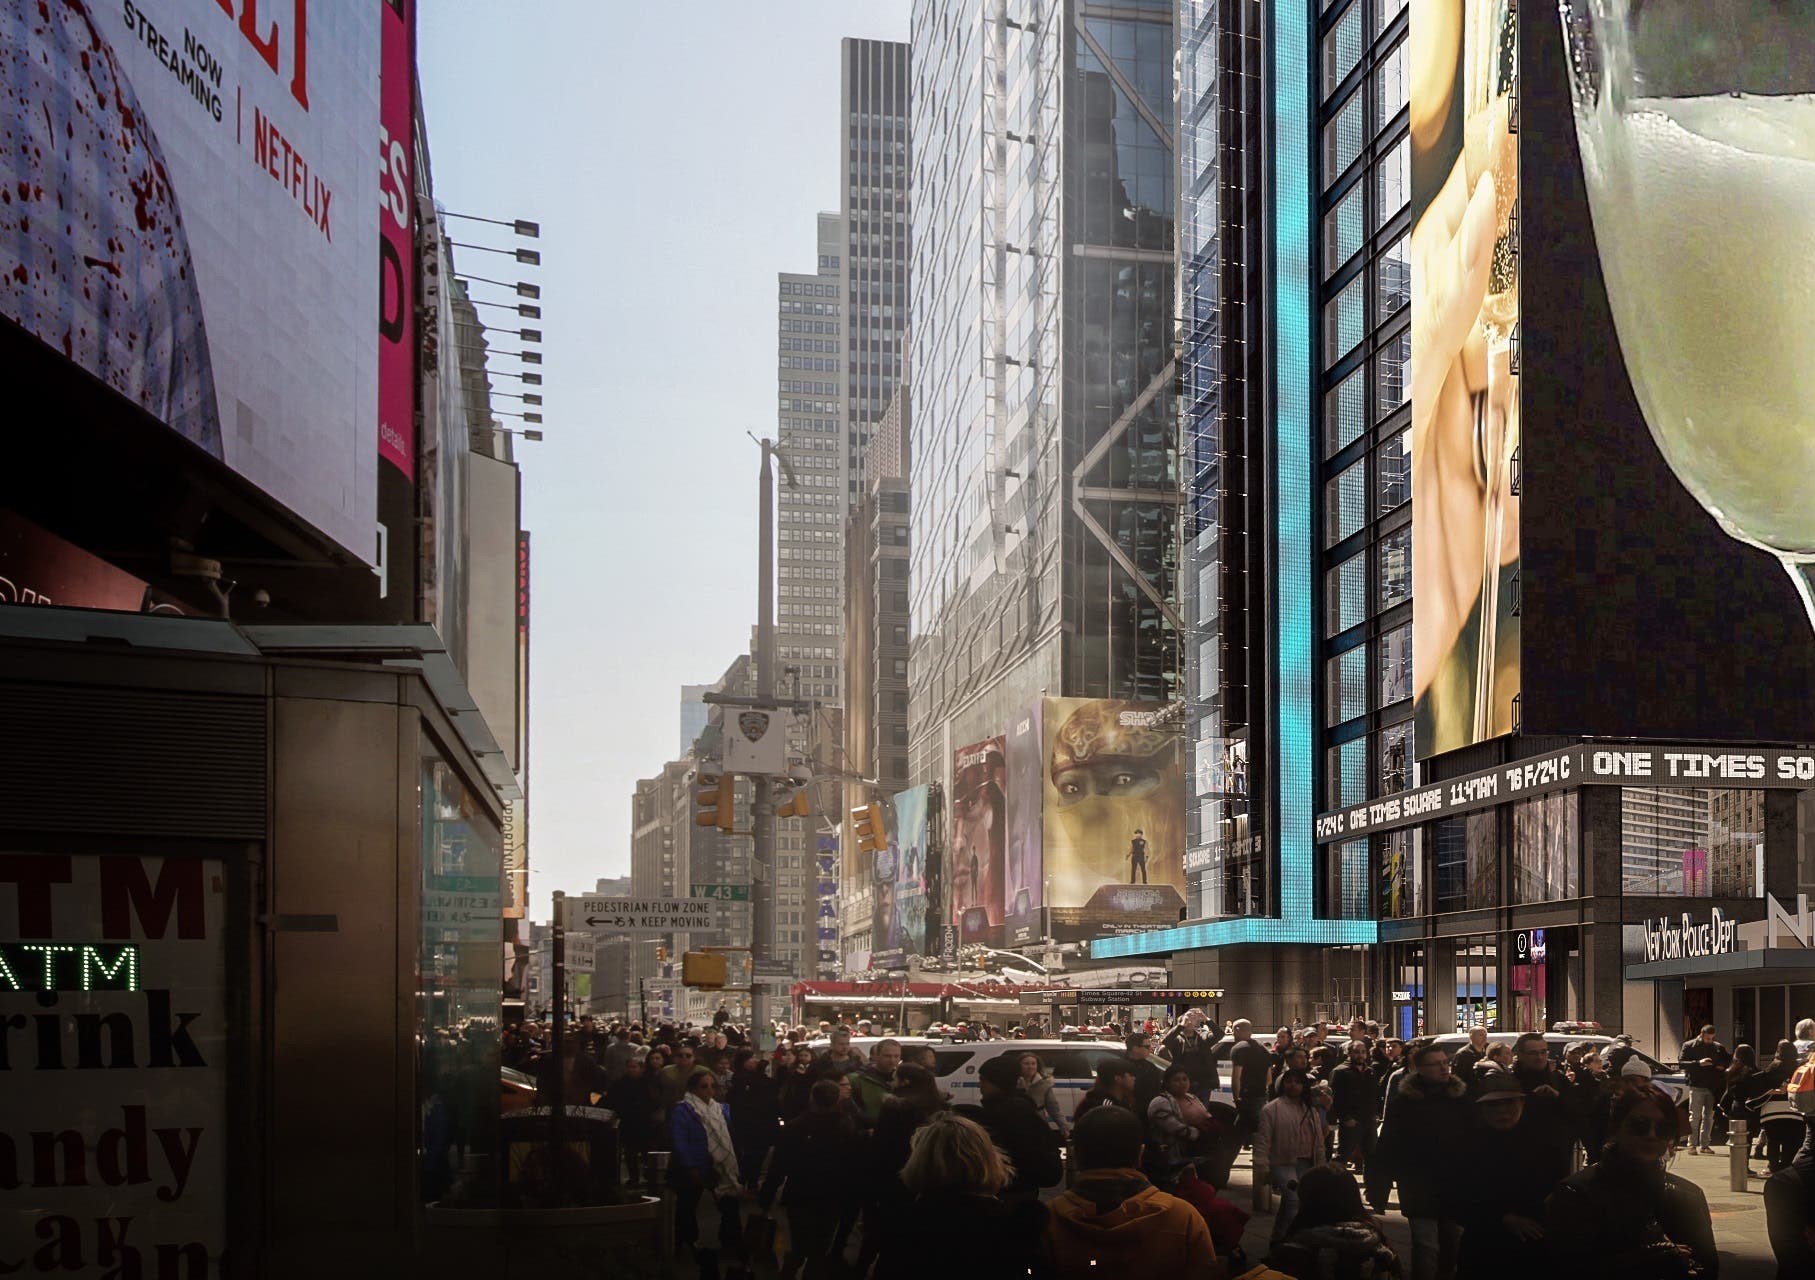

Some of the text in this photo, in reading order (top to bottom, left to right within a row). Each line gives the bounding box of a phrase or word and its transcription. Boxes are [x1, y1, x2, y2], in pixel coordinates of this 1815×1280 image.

[183, 26, 223, 90] NOW
[254, 106, 332, 244] NETFLIX
[1593, 751, 1815, 781] ONE TIMES SQ
[1350, 808, 1367, 829] ONE
[1370, 803, 1401, 825] TIMES
[1404, 788, 1442, 816] SQUARE
[1506, 767, 1523, 792] 76
[584, 901, 710, 914] PEDESTRIAN FLOW ZONE
[695, 886, 707, 898] W
[712, 886, 732, 900] 43
[641, 917, 710, 928] KEEP MOVING
[1644, 907, 1735, 963] NEW YORK POLICE DEPT
[1081, 996, 1106, 1004] Subway
